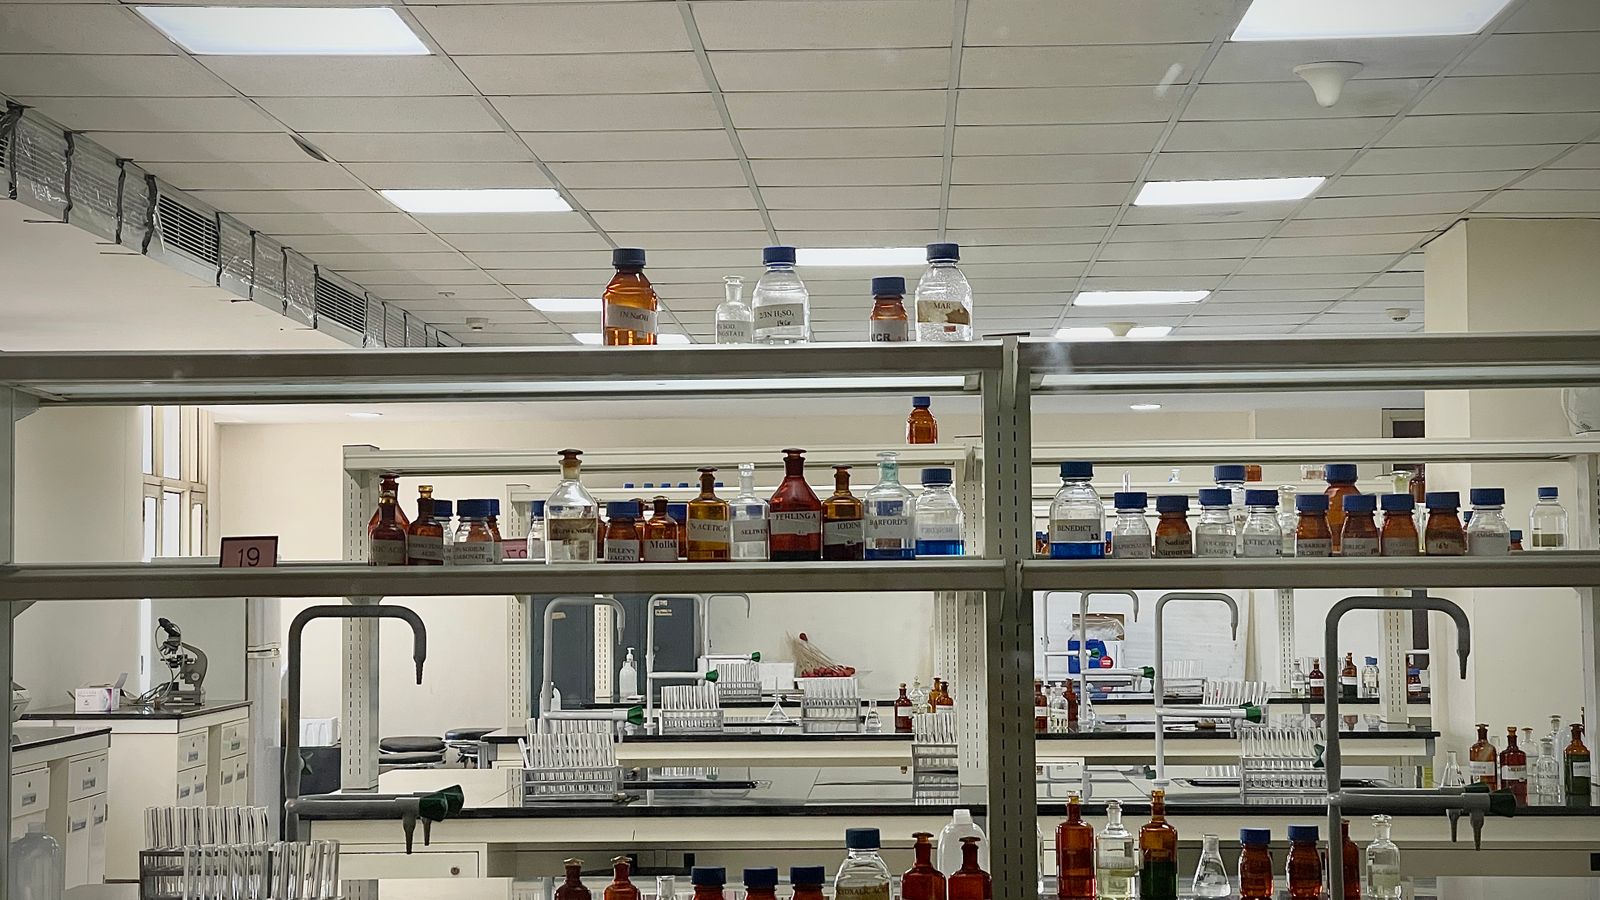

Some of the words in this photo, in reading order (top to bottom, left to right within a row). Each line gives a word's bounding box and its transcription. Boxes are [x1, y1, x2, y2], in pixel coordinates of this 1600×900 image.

[775, 512, 811, 520] FEHLING
[869, 518, 909, 526] BARFORD'S
[238, 546, 260, 567] 19
